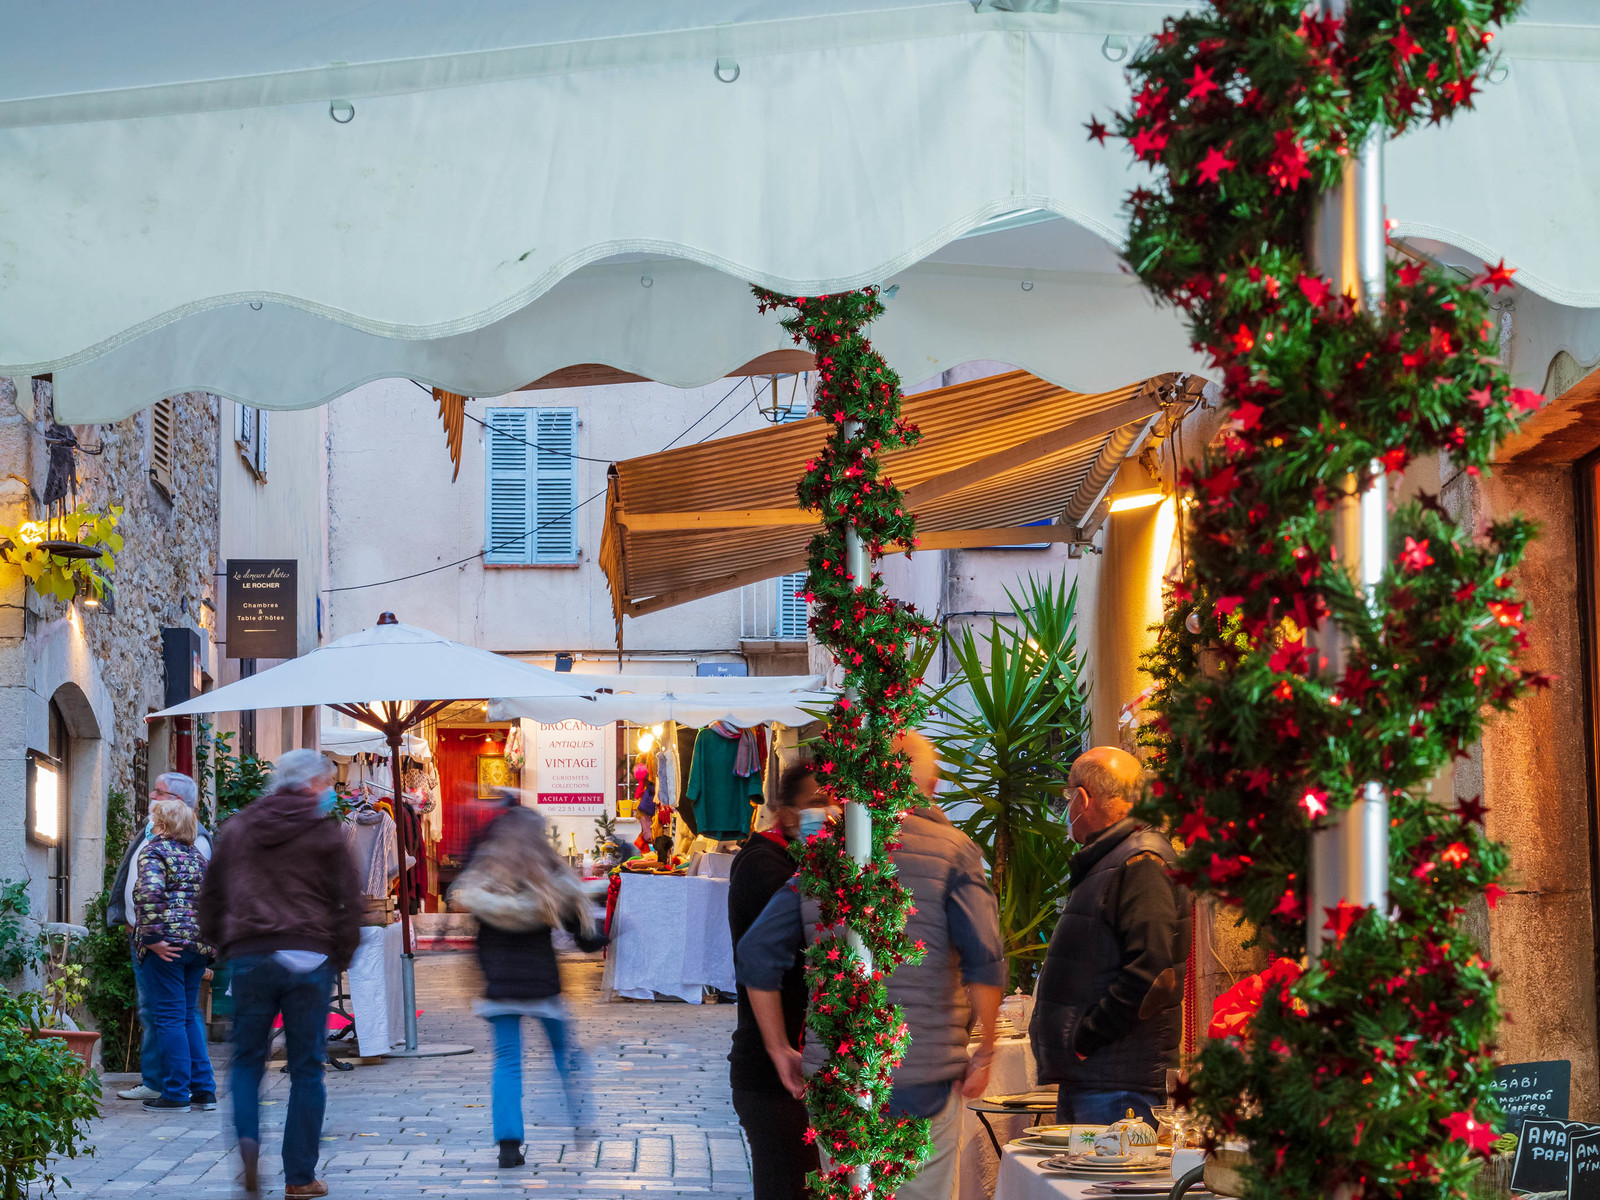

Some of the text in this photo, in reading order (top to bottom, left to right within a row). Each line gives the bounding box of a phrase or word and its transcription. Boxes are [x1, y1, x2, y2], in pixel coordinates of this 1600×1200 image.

[540, 721, 602, 731] BROCANTE
[549, 741, 594, 749] ANTIQUES
[545, 758, 598, 768] VINTAGE
[1489, 1071, 1538, 1089] ASABi
